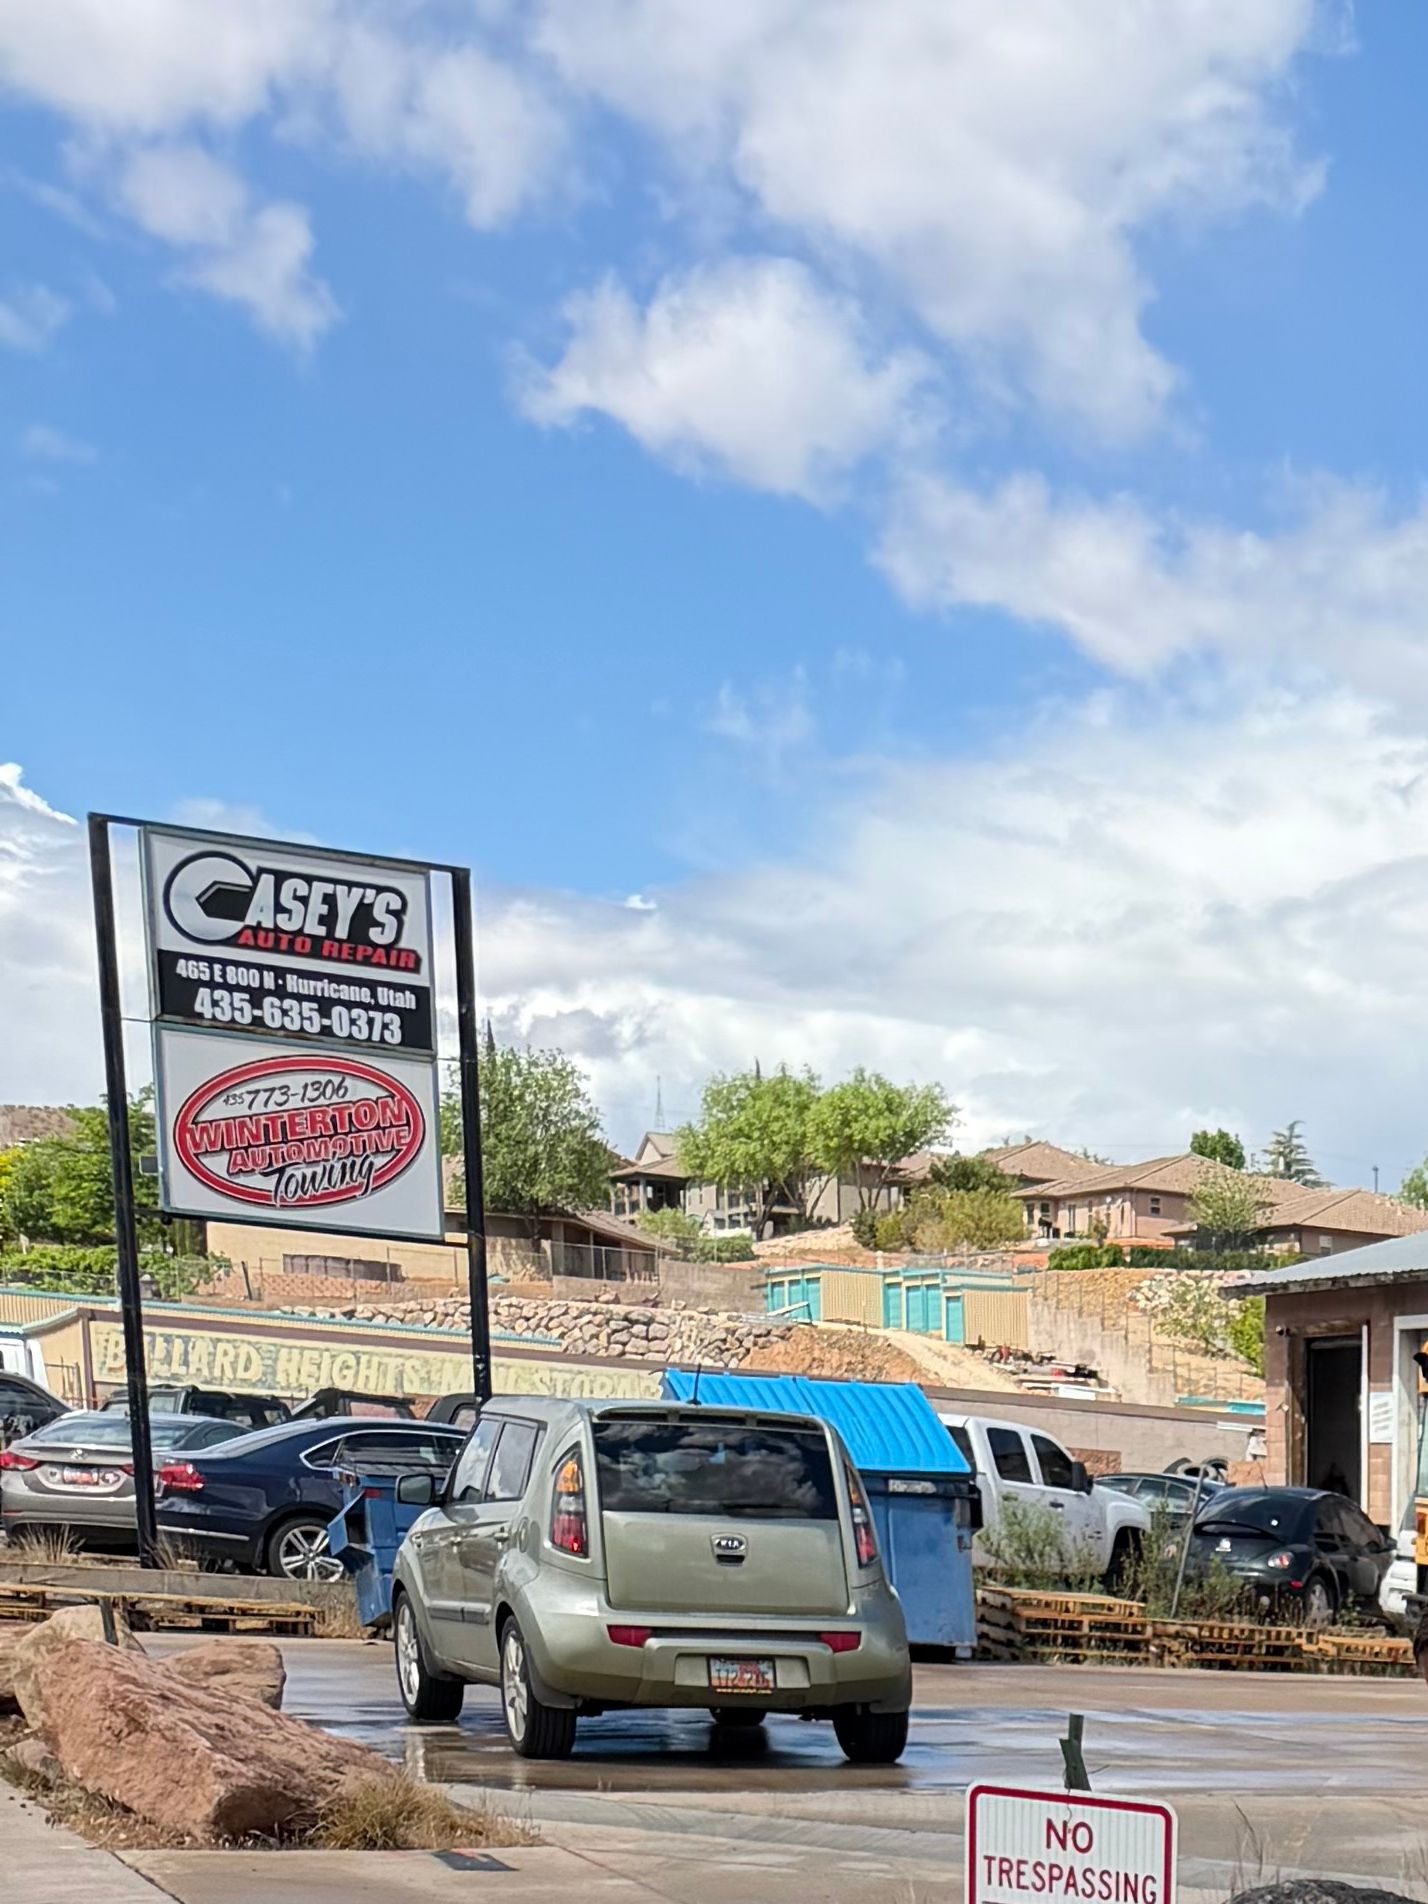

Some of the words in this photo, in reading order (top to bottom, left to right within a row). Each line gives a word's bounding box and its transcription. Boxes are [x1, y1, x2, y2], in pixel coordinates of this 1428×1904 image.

[163, 850, 404, 946] CASEY'S
[237, 929, 311, 954] AUTO
[321, 939, 417, 969] REPAIR
[175, 958, 211, 981] 465
[213, 964, 223, 983] E
[226, 965, 260, 987] 800
[263, 970, 275, 990] N
[376, 986, 417, 1010] Utah
[194, 987, 402, 1045] 435-635-0373
[186, 1096, 407, 1153] WINTERTON
[227, 1125, 410, 1176] AUTOMOTIVE
[259, 1153, 375, 1208] Towing
[276, 1348, 422, 1395] HEIGHTS
[1046, 1817, 1093, 1853] NO
